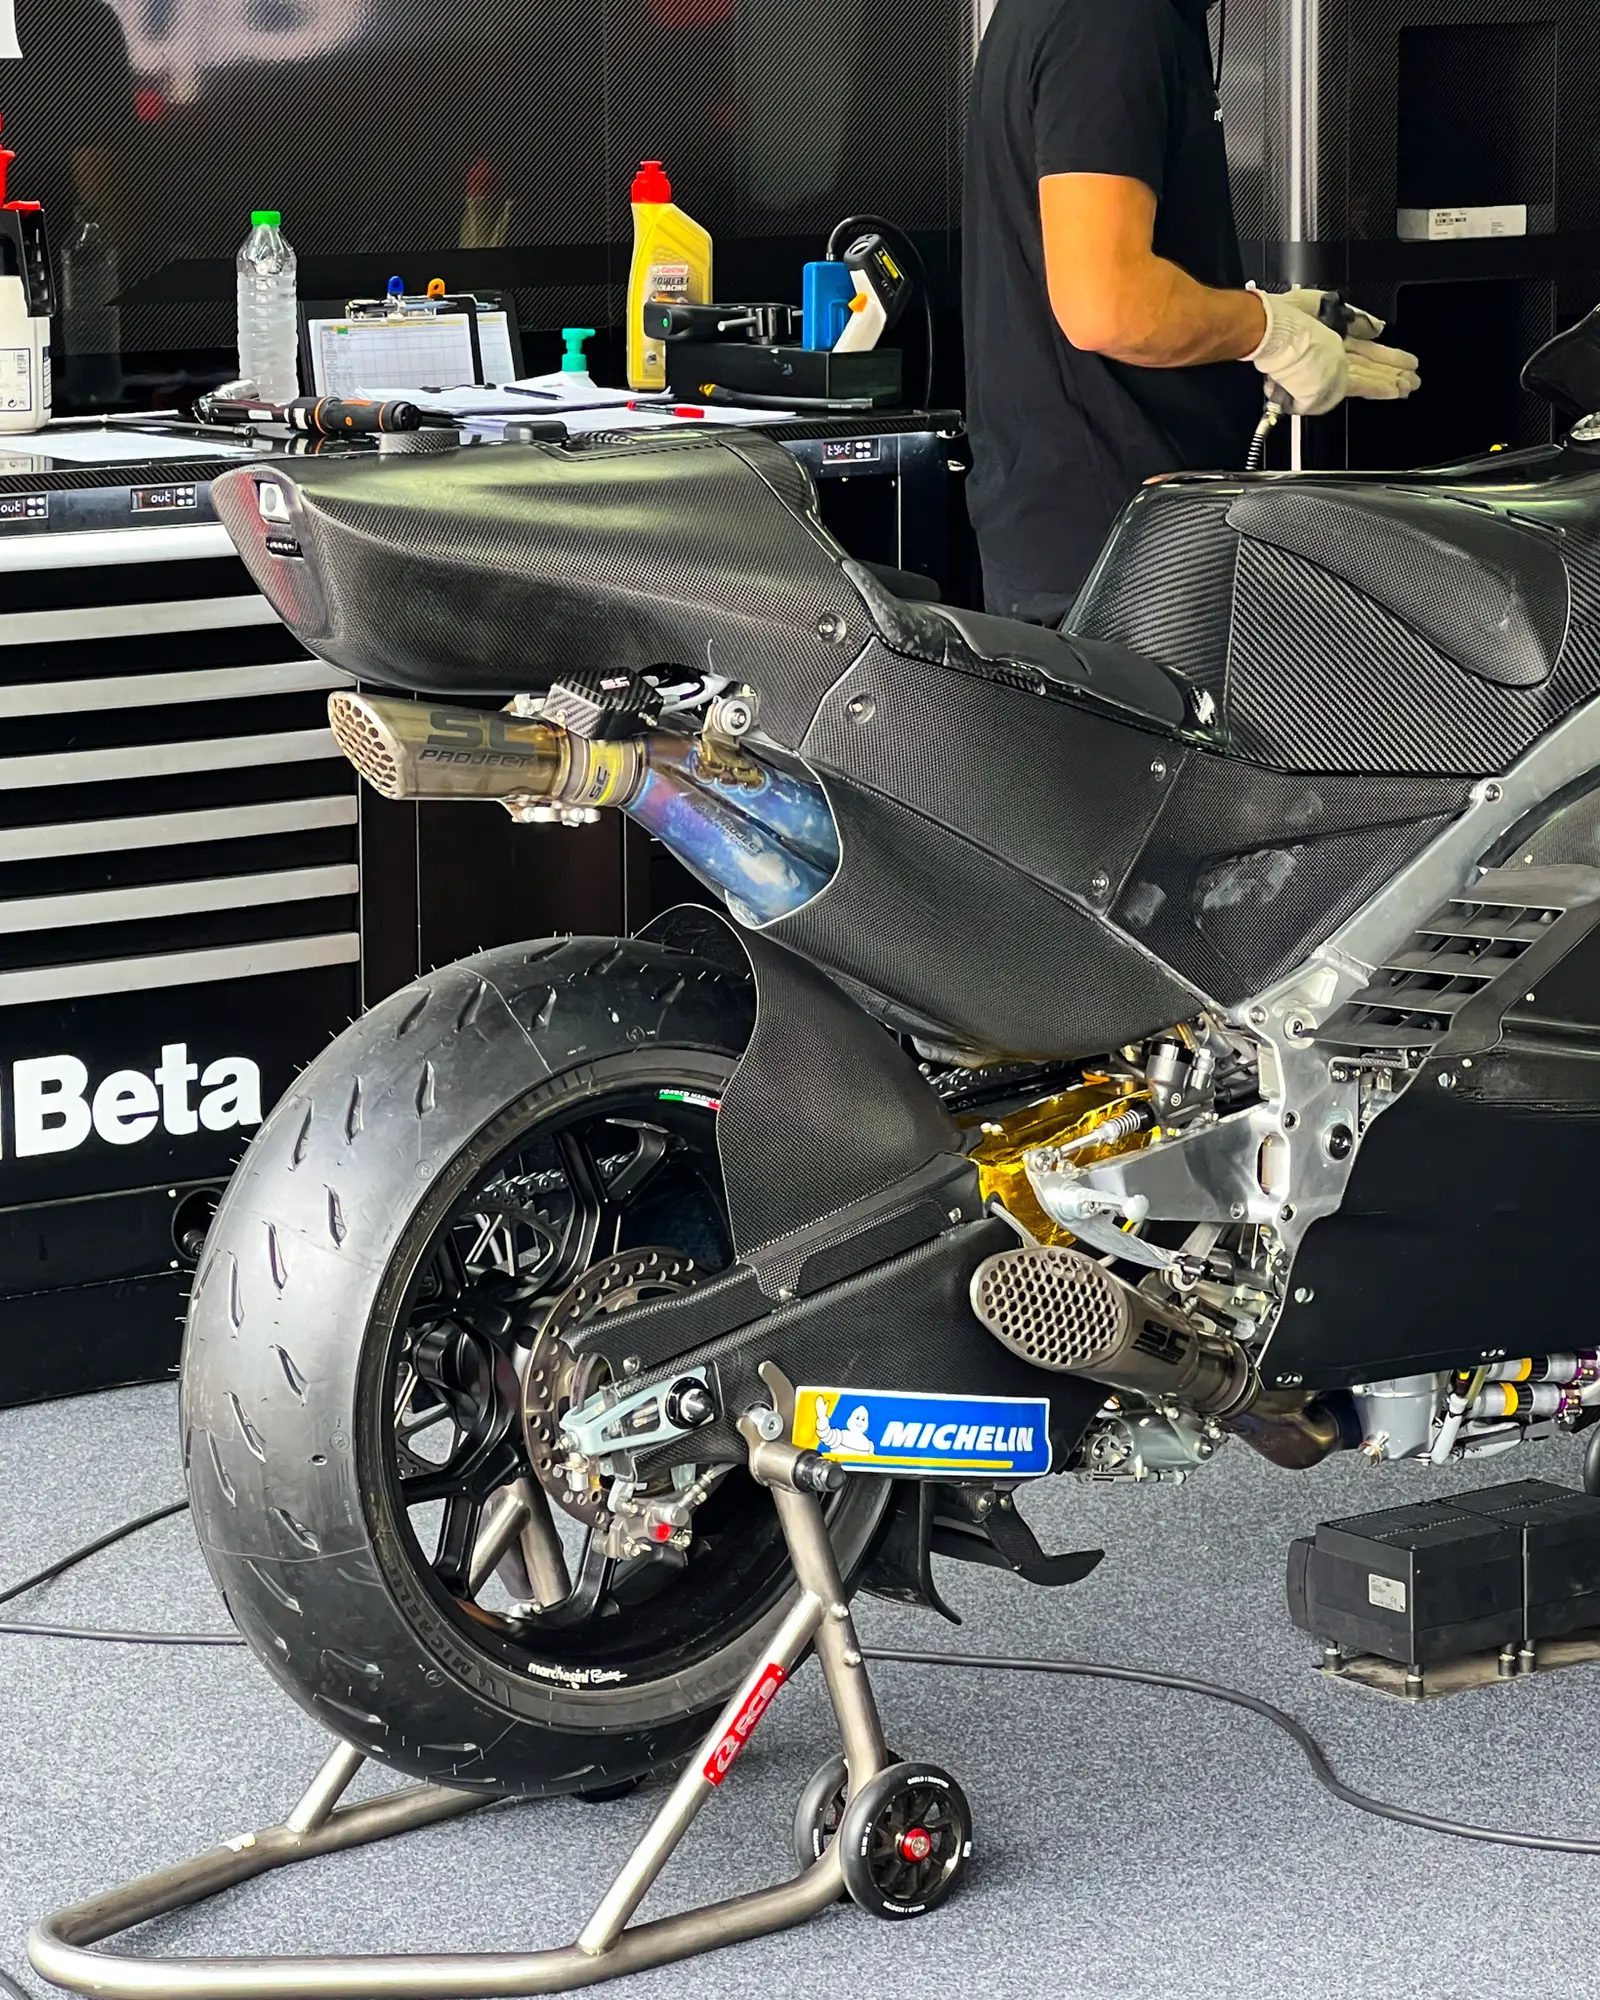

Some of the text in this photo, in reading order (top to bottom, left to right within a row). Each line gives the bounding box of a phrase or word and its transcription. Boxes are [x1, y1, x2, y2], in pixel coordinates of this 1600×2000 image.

[150, 490, 171, 504] out
[427, 711, 535, 754] SC
[418, 749, 534, 768] PROJECT
[590, 766, 609, 799] SC
[13, 1042, 263, 1158] Beta
[879, 1421, 1034, 1452] MICHELIN
